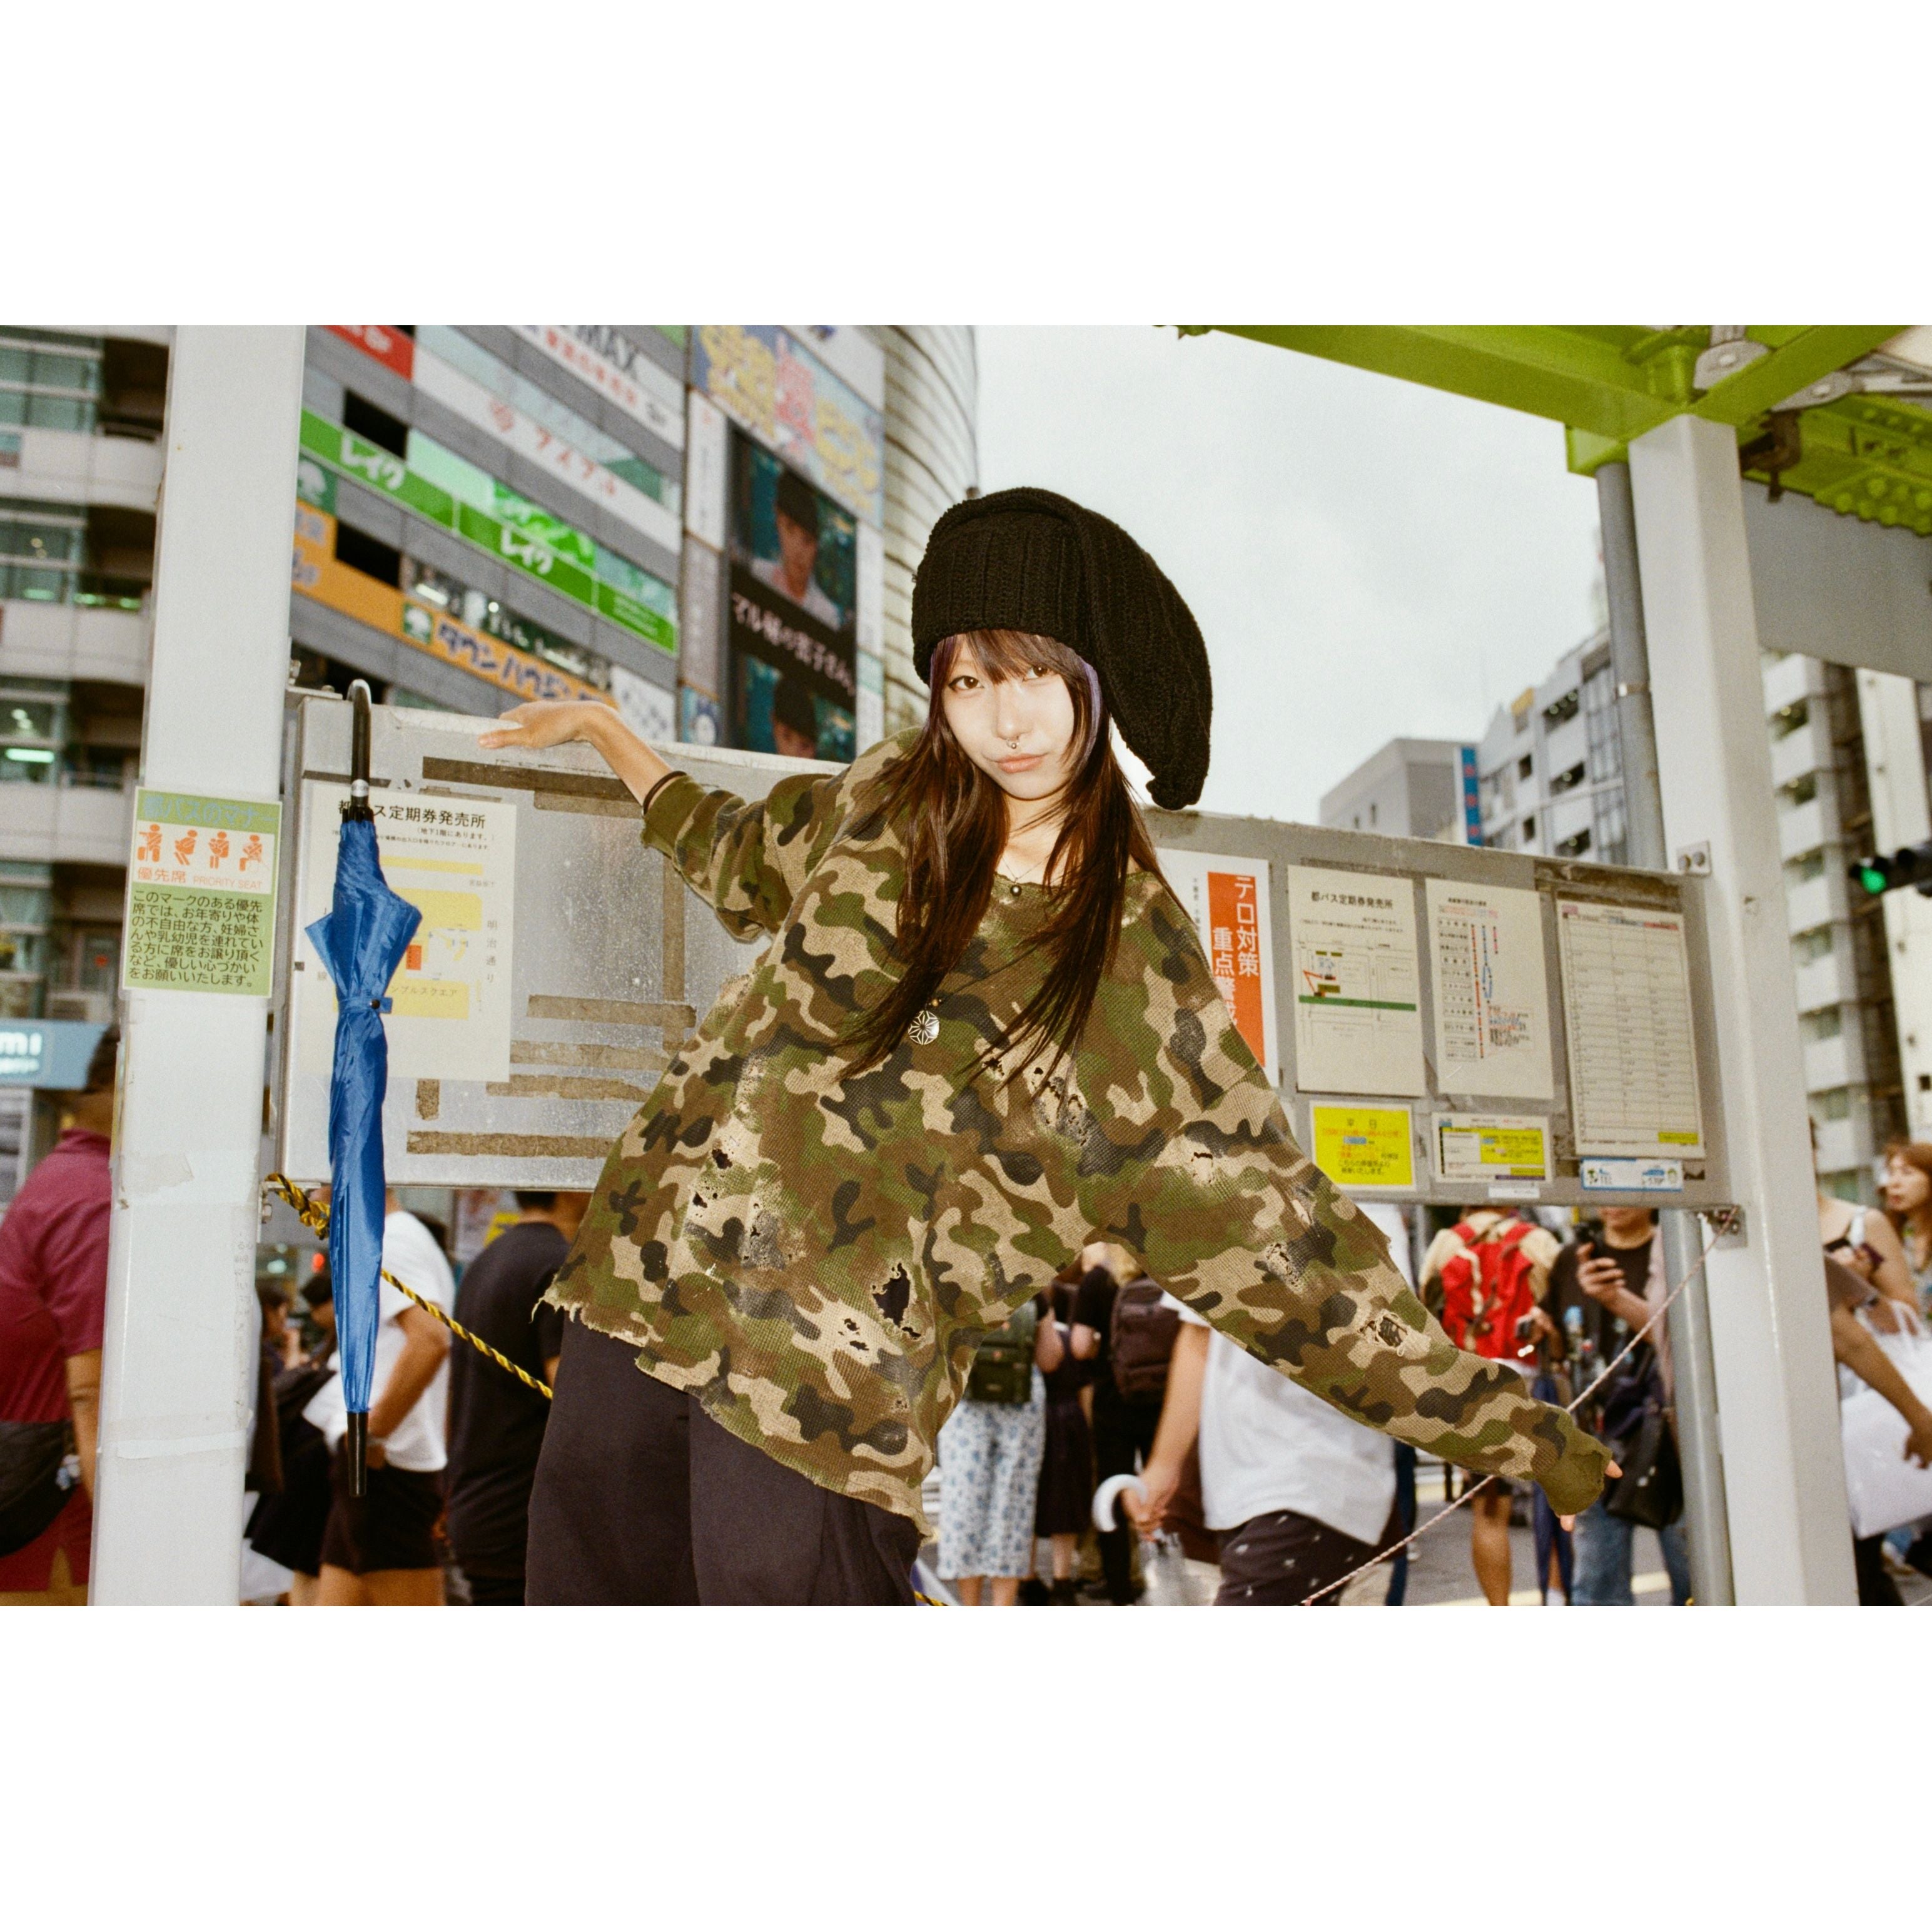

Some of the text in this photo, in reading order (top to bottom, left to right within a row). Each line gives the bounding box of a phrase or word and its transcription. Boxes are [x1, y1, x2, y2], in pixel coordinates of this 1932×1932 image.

[342, 436, 405, 491] レイク
[501, 526, 554, 575] レイク
[438, 622, 598, 701] タウンハウジ
[338, 799, 486, 829] 都ス定期券発売所
[138, 867, 263, 889] 優先席 PRIORITY SEAT
[134, 890, 262, 913] このマークのある優先
[133, 903, 259, 924] 席では、お年寄りや体
[132, 916, 260, 937] の不自由な方、妊婦さ
[1235, 876, 1259, 978] テロ対策
[131, 929, 263, 949] んや乳幼児を連れてい
[131, 941, 259, 962] る方に席をお譲り頂く
[129, 954, 256, 974] など、優しい心づかい
